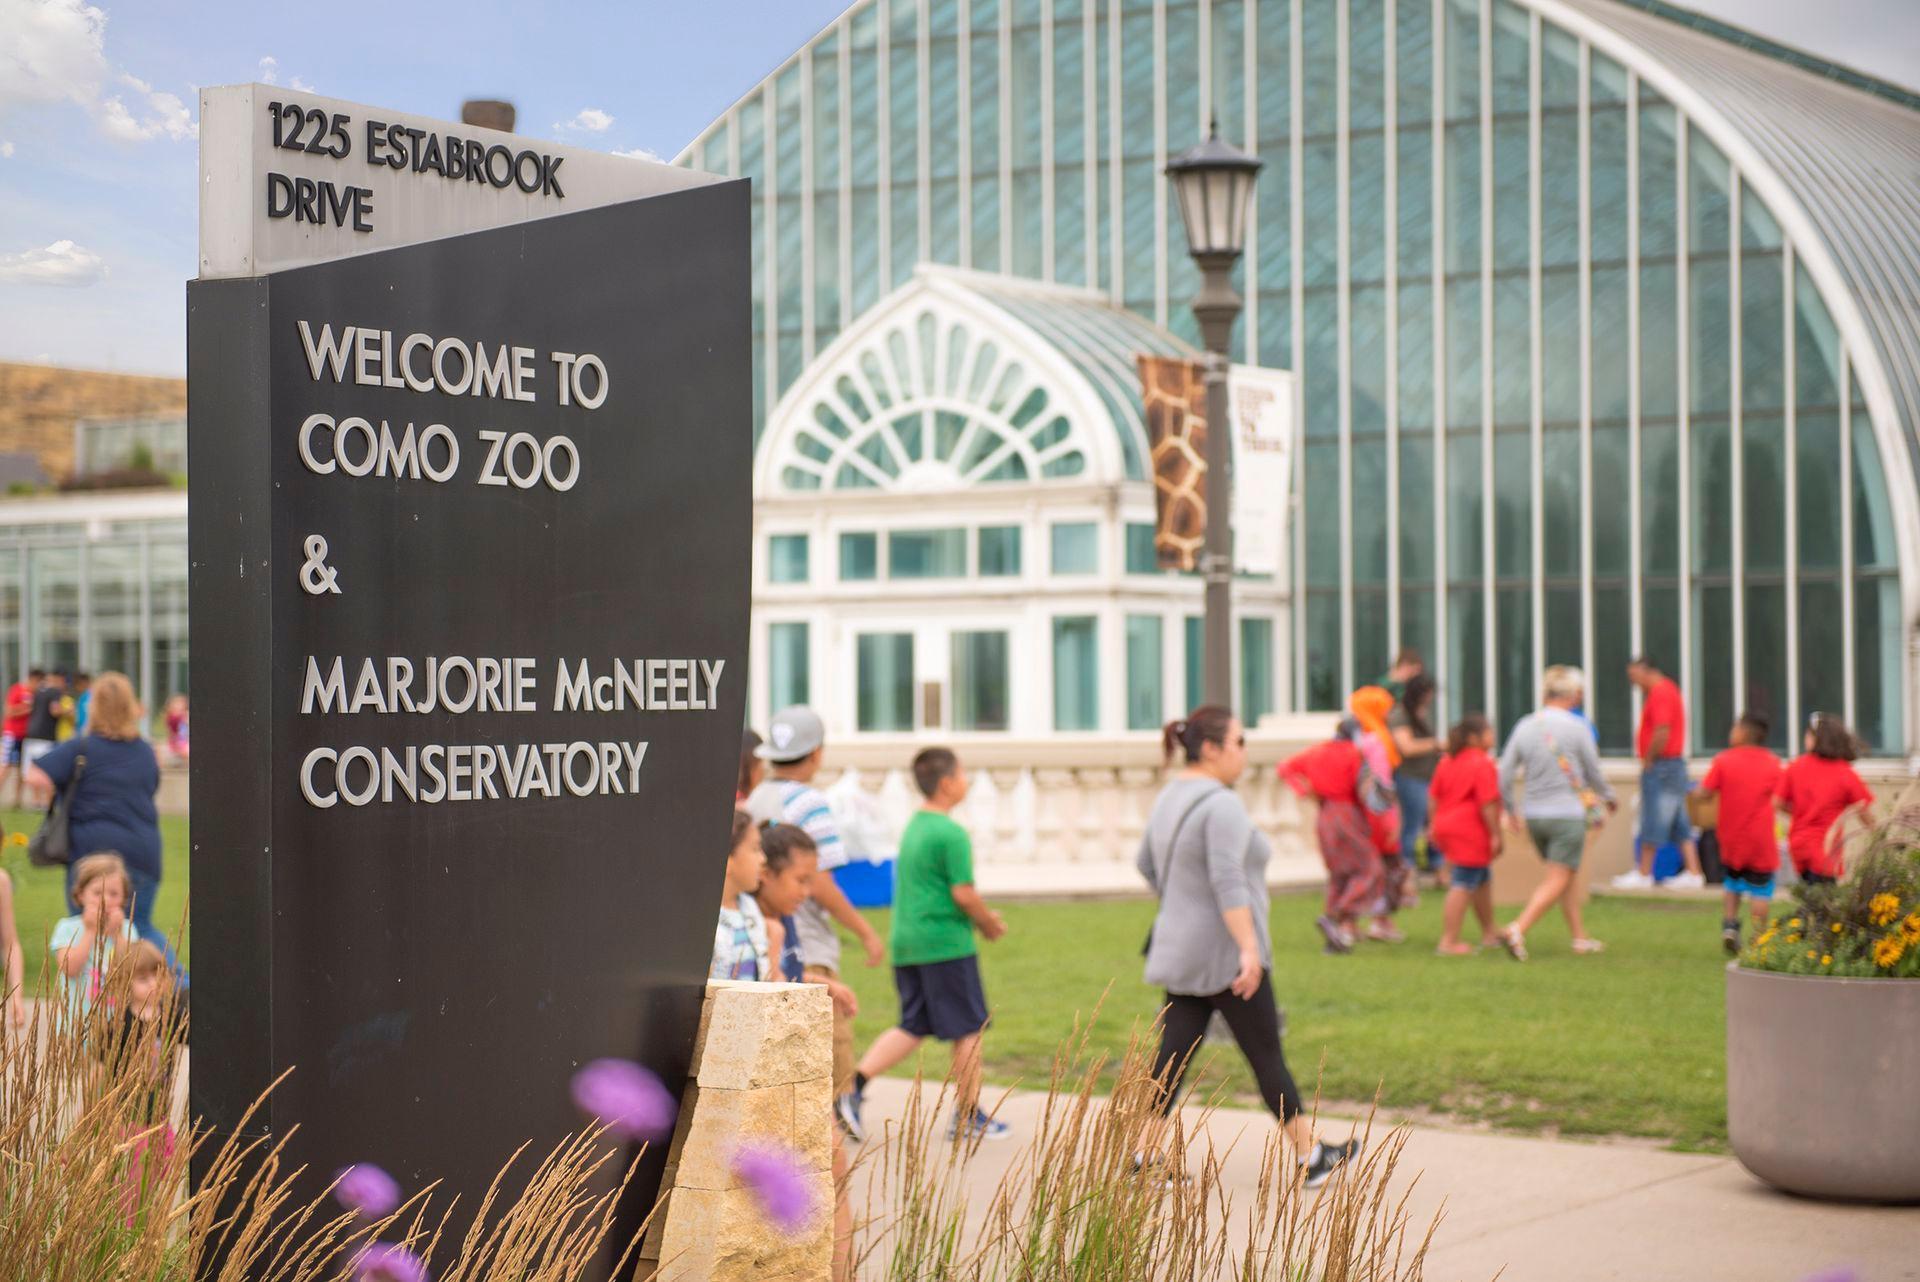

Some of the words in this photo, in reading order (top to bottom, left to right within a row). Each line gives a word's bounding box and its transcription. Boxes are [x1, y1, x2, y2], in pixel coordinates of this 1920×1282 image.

[269, 102, 351, 159] 1225
[367, 120, 565, 198] ESTABROOK
[268, 173, 373, 233] DRIVE
[297, 320, 536, 402] WELCOME
[552, 351, 609, 410] TO
[299, 413, 460, 483] COMO
[478, 430, 580, 492] ZOO
[300, 534, 342, 595] &
[300, 655, 536, 715] MARJORIE
[553, 657, 726, 712] McNEELY
[300, 741, 649, 809] CONSERVATORY
